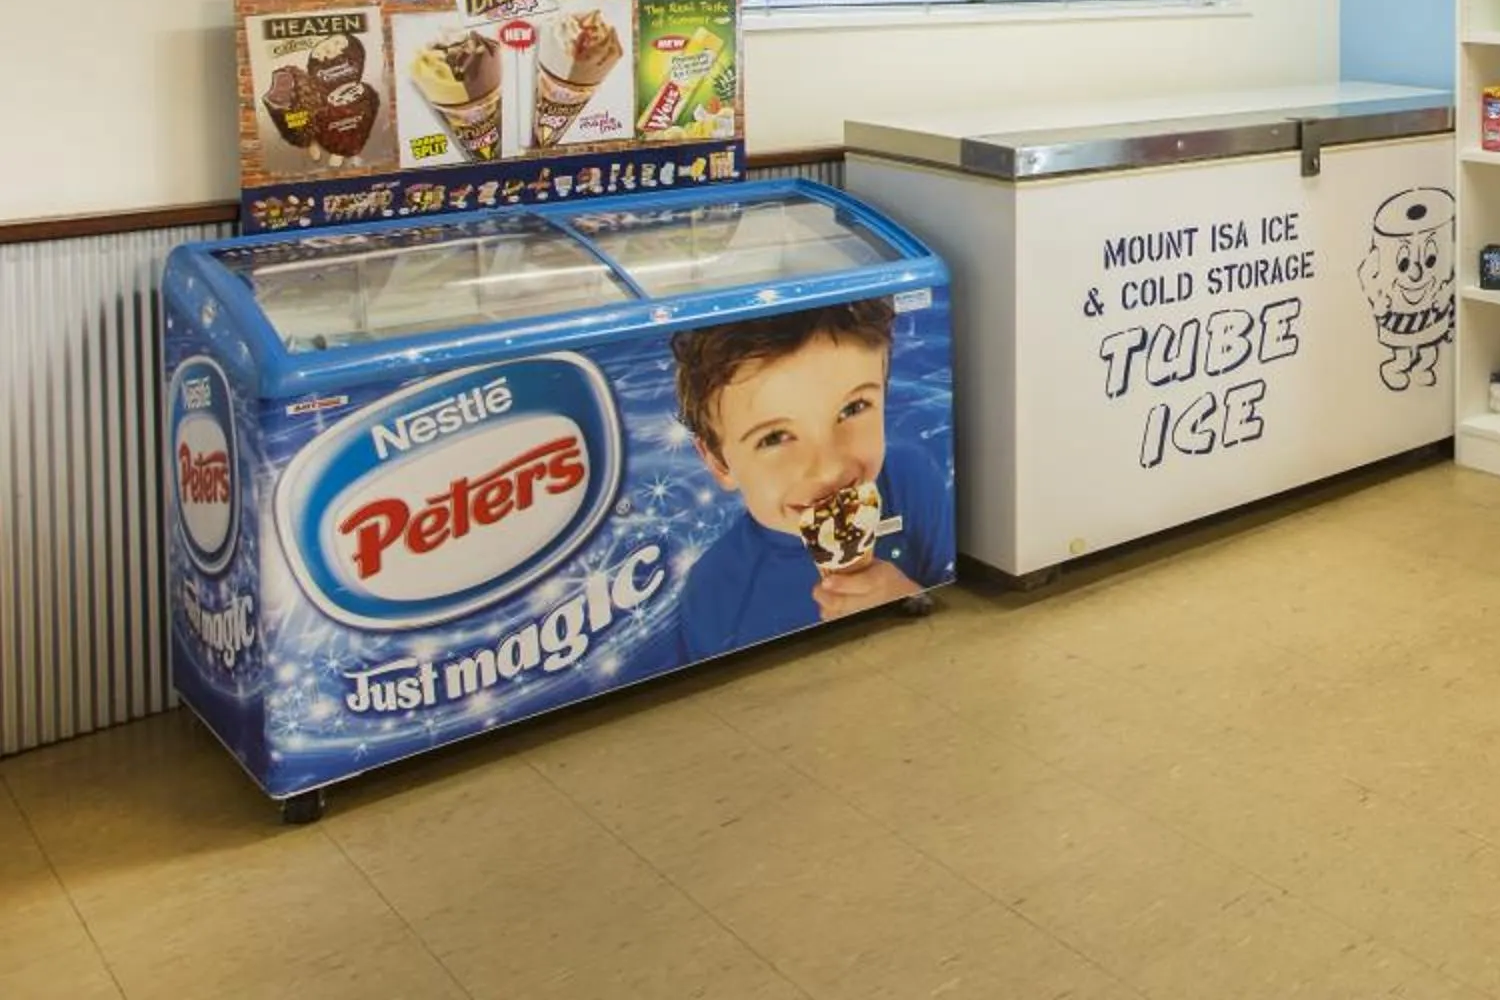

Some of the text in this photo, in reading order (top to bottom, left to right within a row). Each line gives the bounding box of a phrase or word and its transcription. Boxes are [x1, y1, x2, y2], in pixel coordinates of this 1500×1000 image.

[270, 14, 362, 37] HEAVEN
[1083, 249, 1316, 317] & COLD STORAGE
[1103, 213, 1299, 271] MOUNT ISA ICE
[1100, 297, 1302, 399] TUBE
[372, 377, 514, 460] Nestlé
[1139, 379, 1267, 470] ICE
[178, 441, 230, 505] Peters
[339, 435, 586, 580] Peters
[344, 543, 665, 713] Just magic
